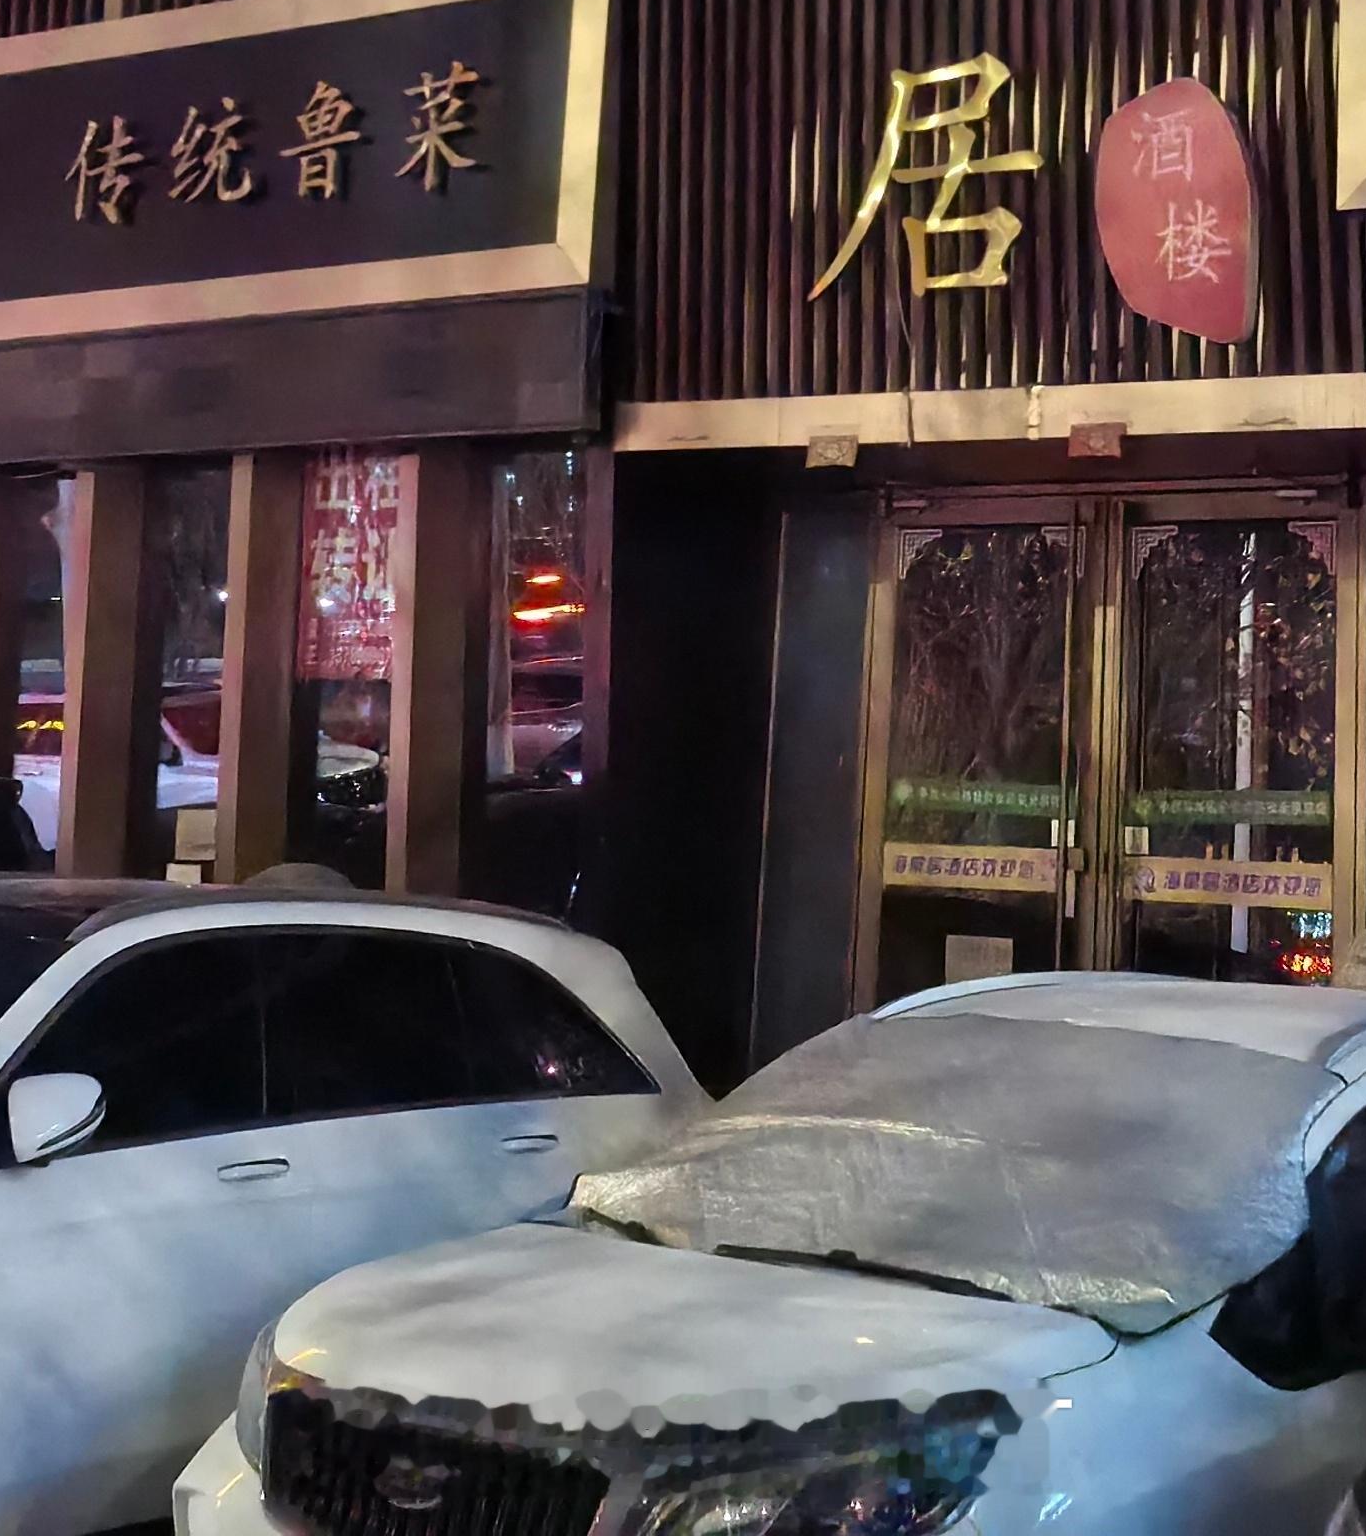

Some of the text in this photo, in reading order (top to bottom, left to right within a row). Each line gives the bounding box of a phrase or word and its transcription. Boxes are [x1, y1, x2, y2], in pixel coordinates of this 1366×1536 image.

[64, 60, 486, 225] 传统鲁菜
[1130, 110, 1233, 285] 酒楼
